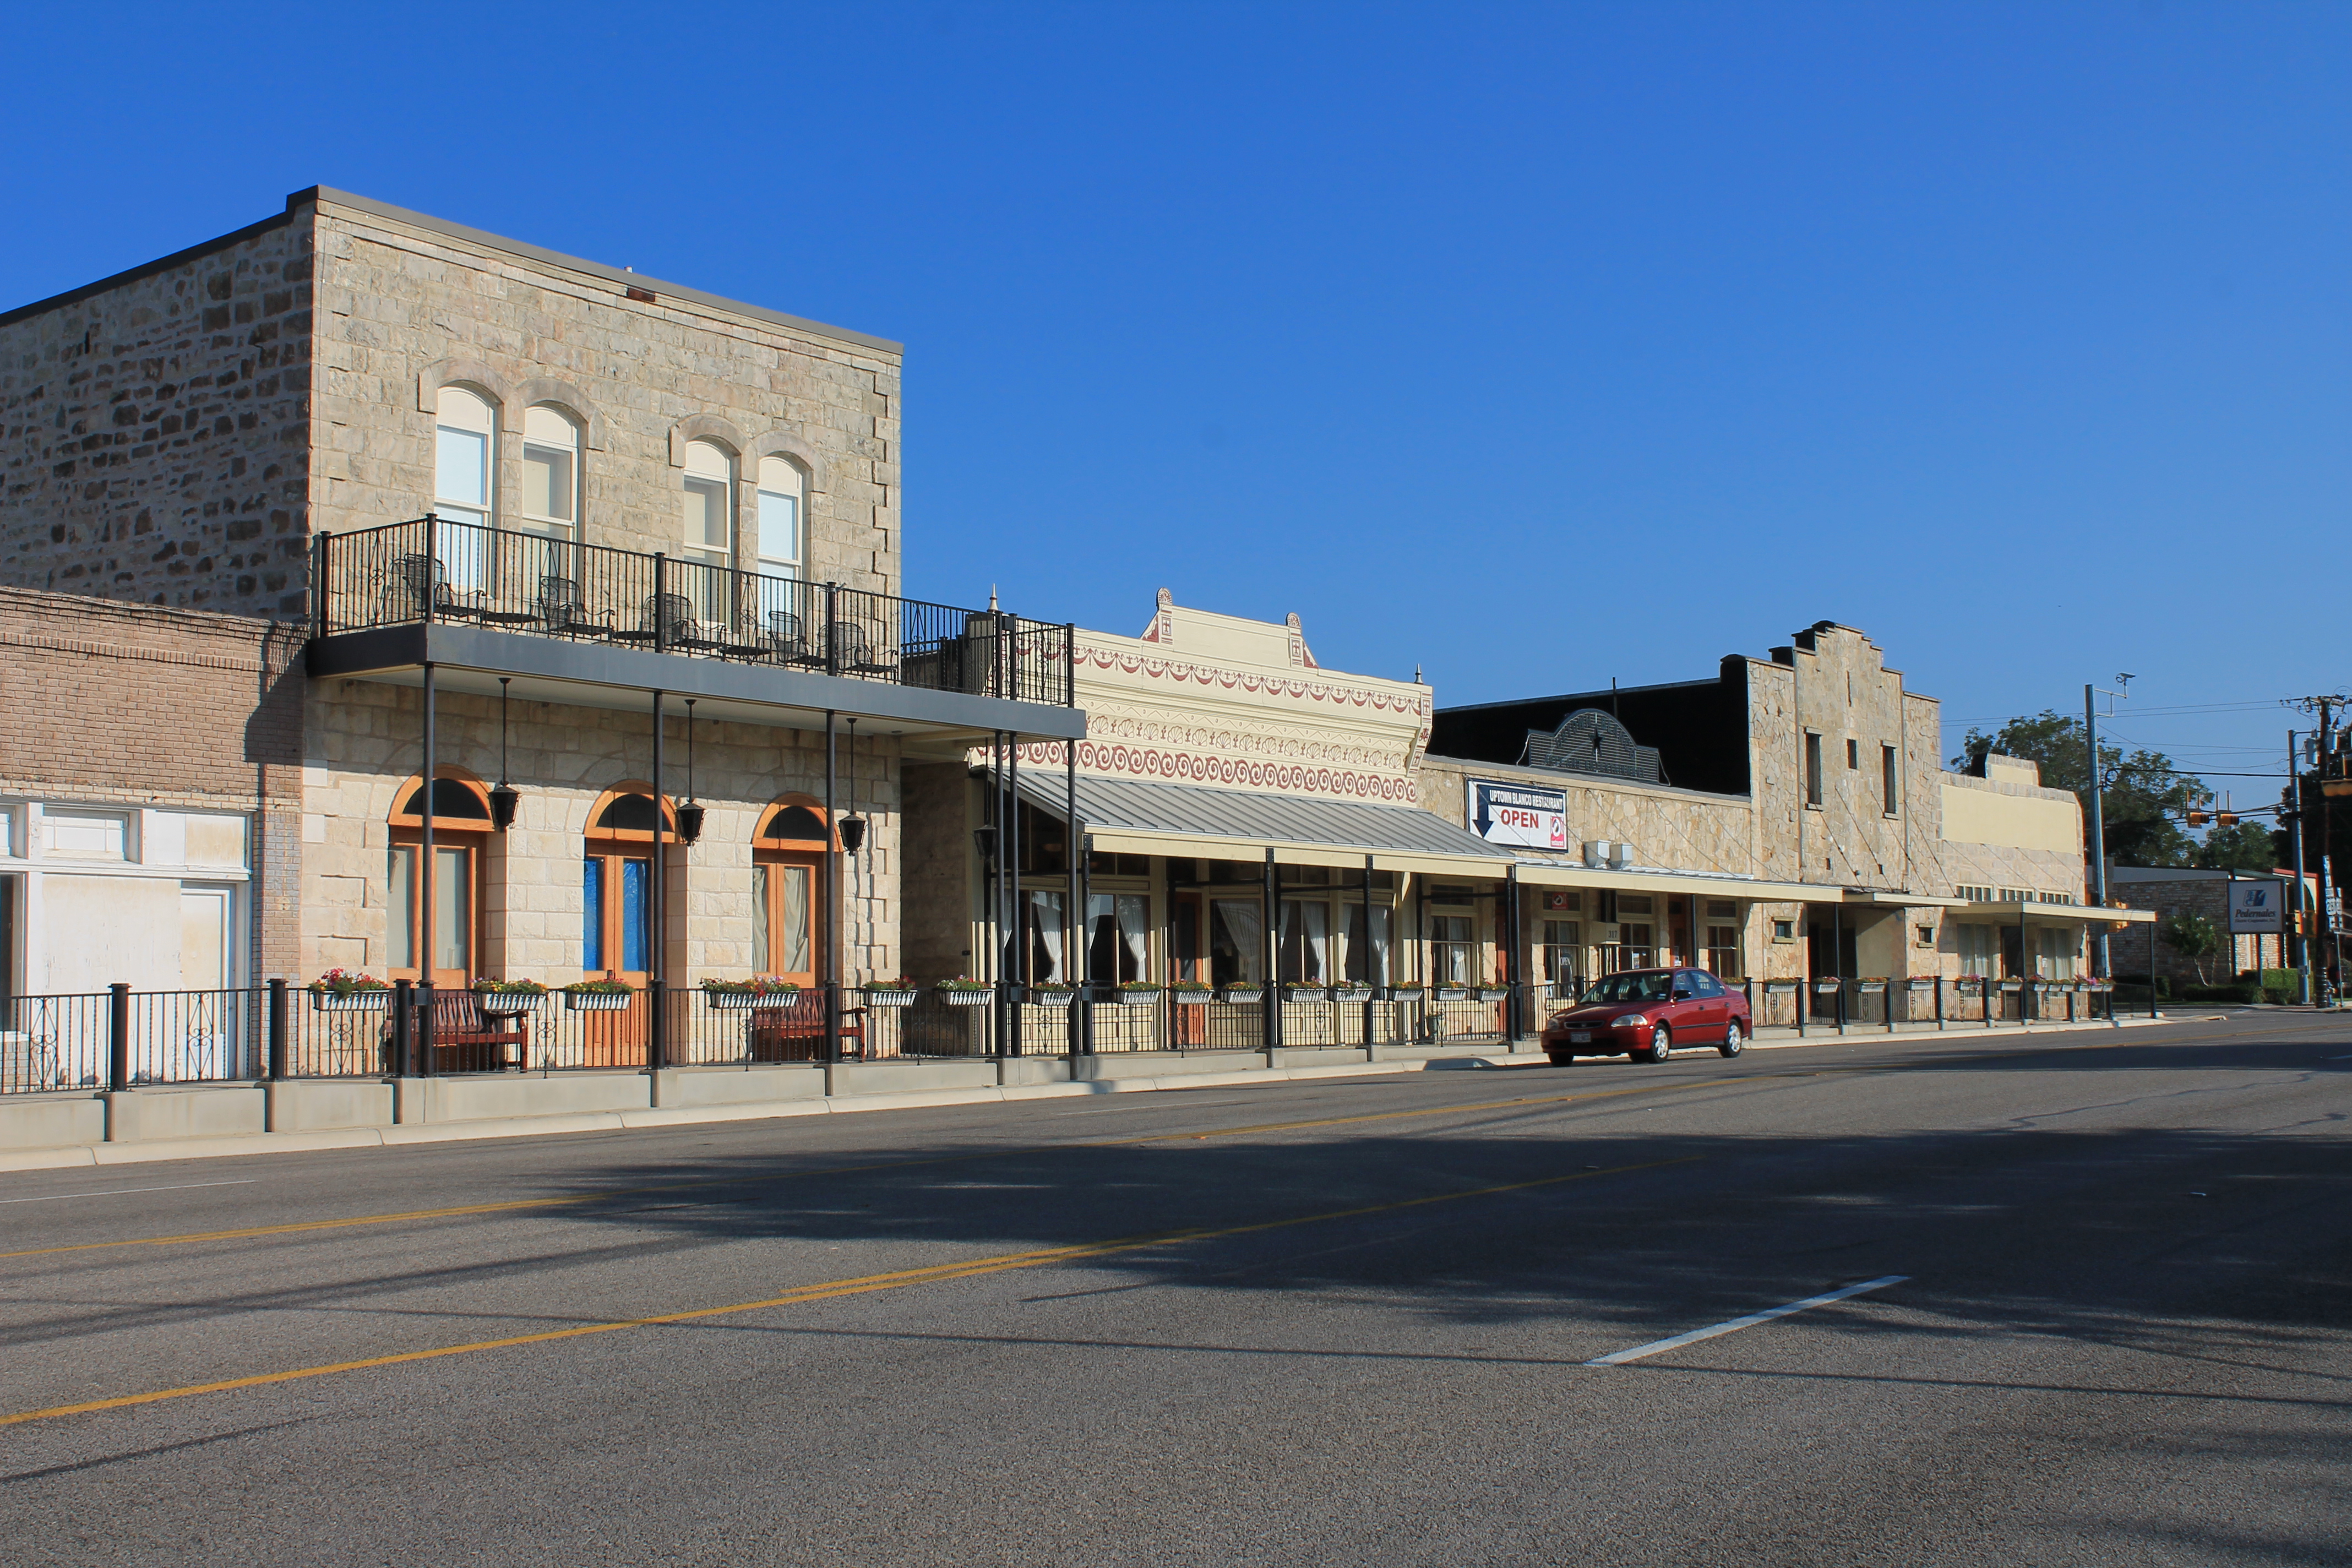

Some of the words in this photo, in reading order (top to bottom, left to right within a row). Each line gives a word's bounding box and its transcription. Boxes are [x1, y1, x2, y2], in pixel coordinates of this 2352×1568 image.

[1489, 789, 1512, 804] UPTOWN
[1512, 792, 1532, 806] BLANCO
[1532, 794, 1563, 810] RESTAURANT
[1501, 809, 1539, 829] OPEN
[2235, 908, 2276, 917] Pedernales
